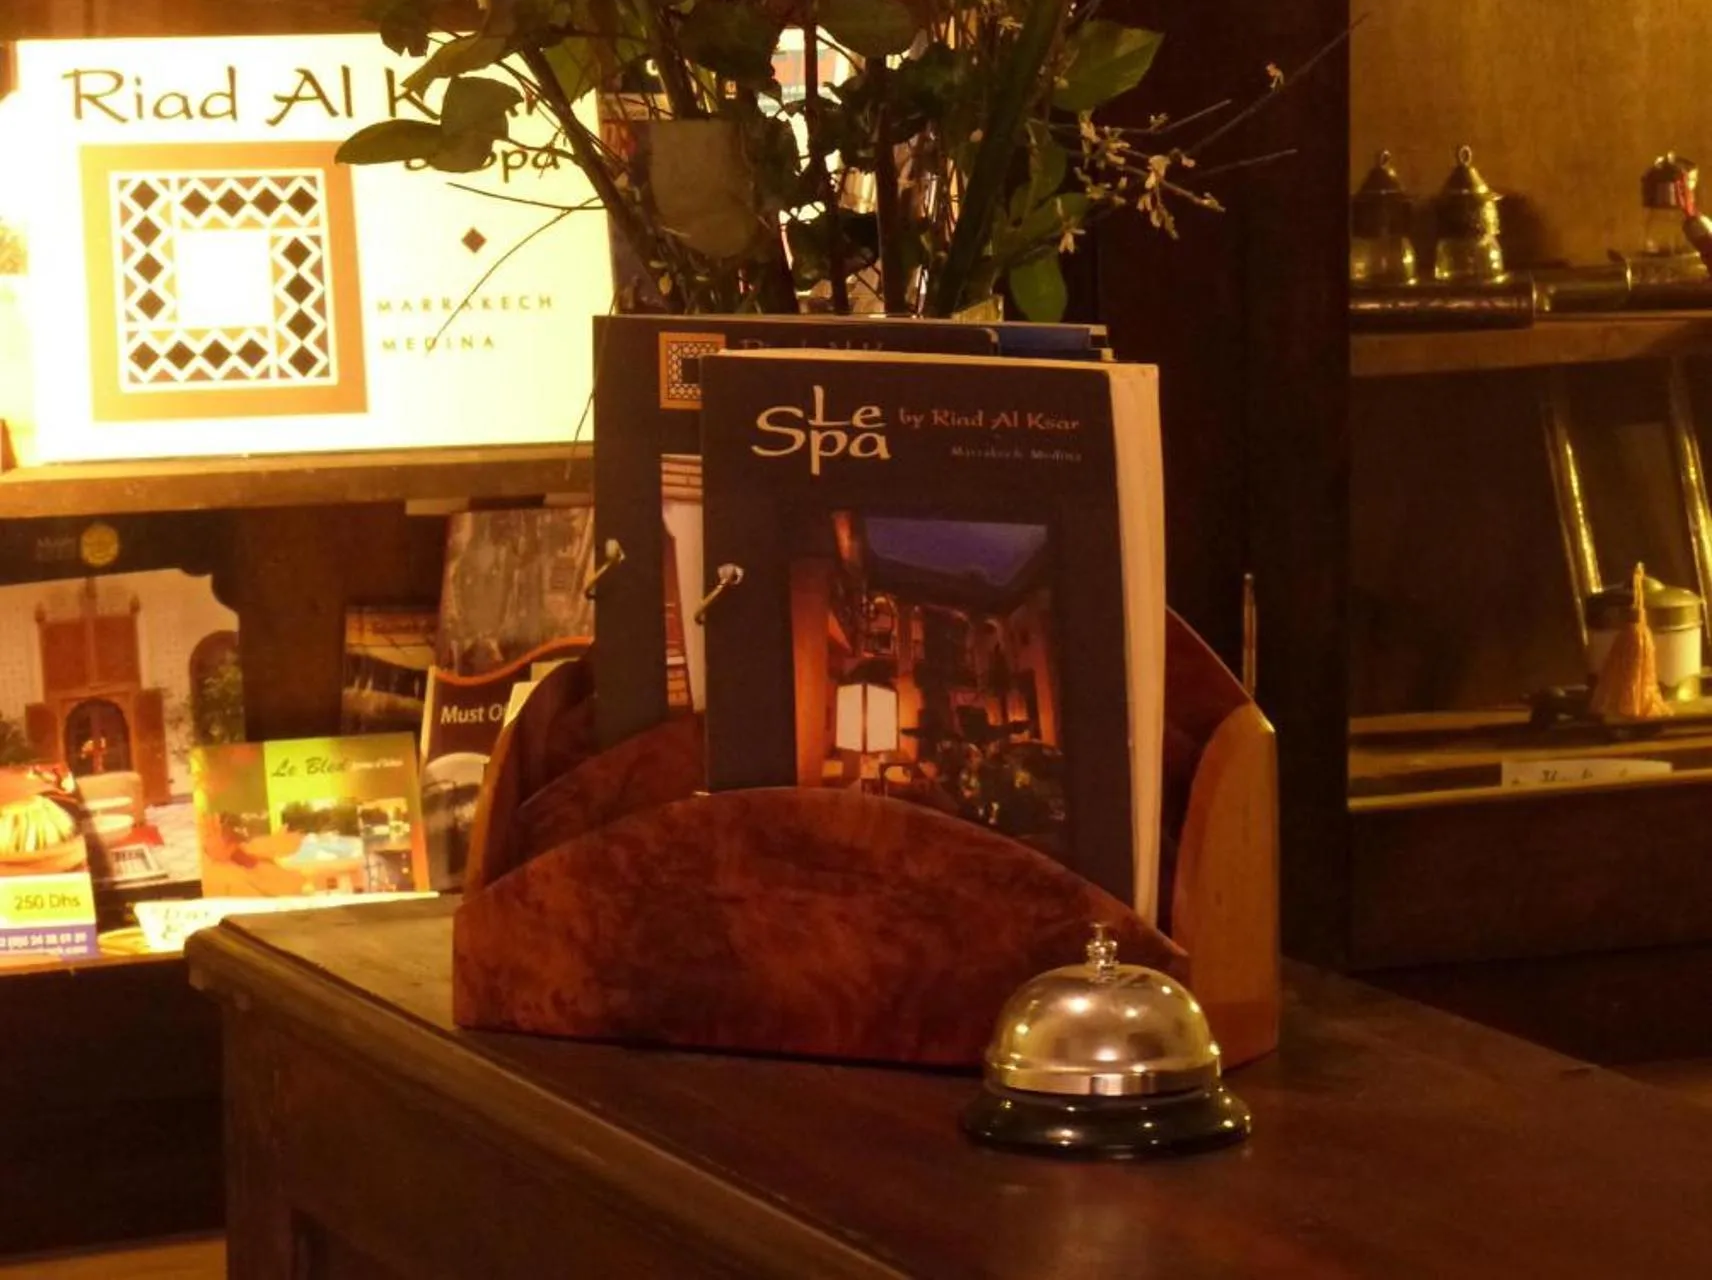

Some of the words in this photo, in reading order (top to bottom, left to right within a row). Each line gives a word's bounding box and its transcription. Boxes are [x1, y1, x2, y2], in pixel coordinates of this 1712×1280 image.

[61, 65, 239, 124] Riad
[265, 64, 354, 127] Al
[376, 295, 553, 312] MARRAKECH
[382, 335, 495, 352] MEDINA
[806, 384, 888, 429] Le
[899, 407, 926, 430] by
[931, 408, 984, 428] Riad
[990, 410, 1019, 431] Al
[1026, 411, 1081, 431] Ksar
[750, 405, 893, 477] Spa
[440, 704, 485, 725] Must
[14, 894, 45, 911] 250
[48, 892, 82, 909] Dhs
